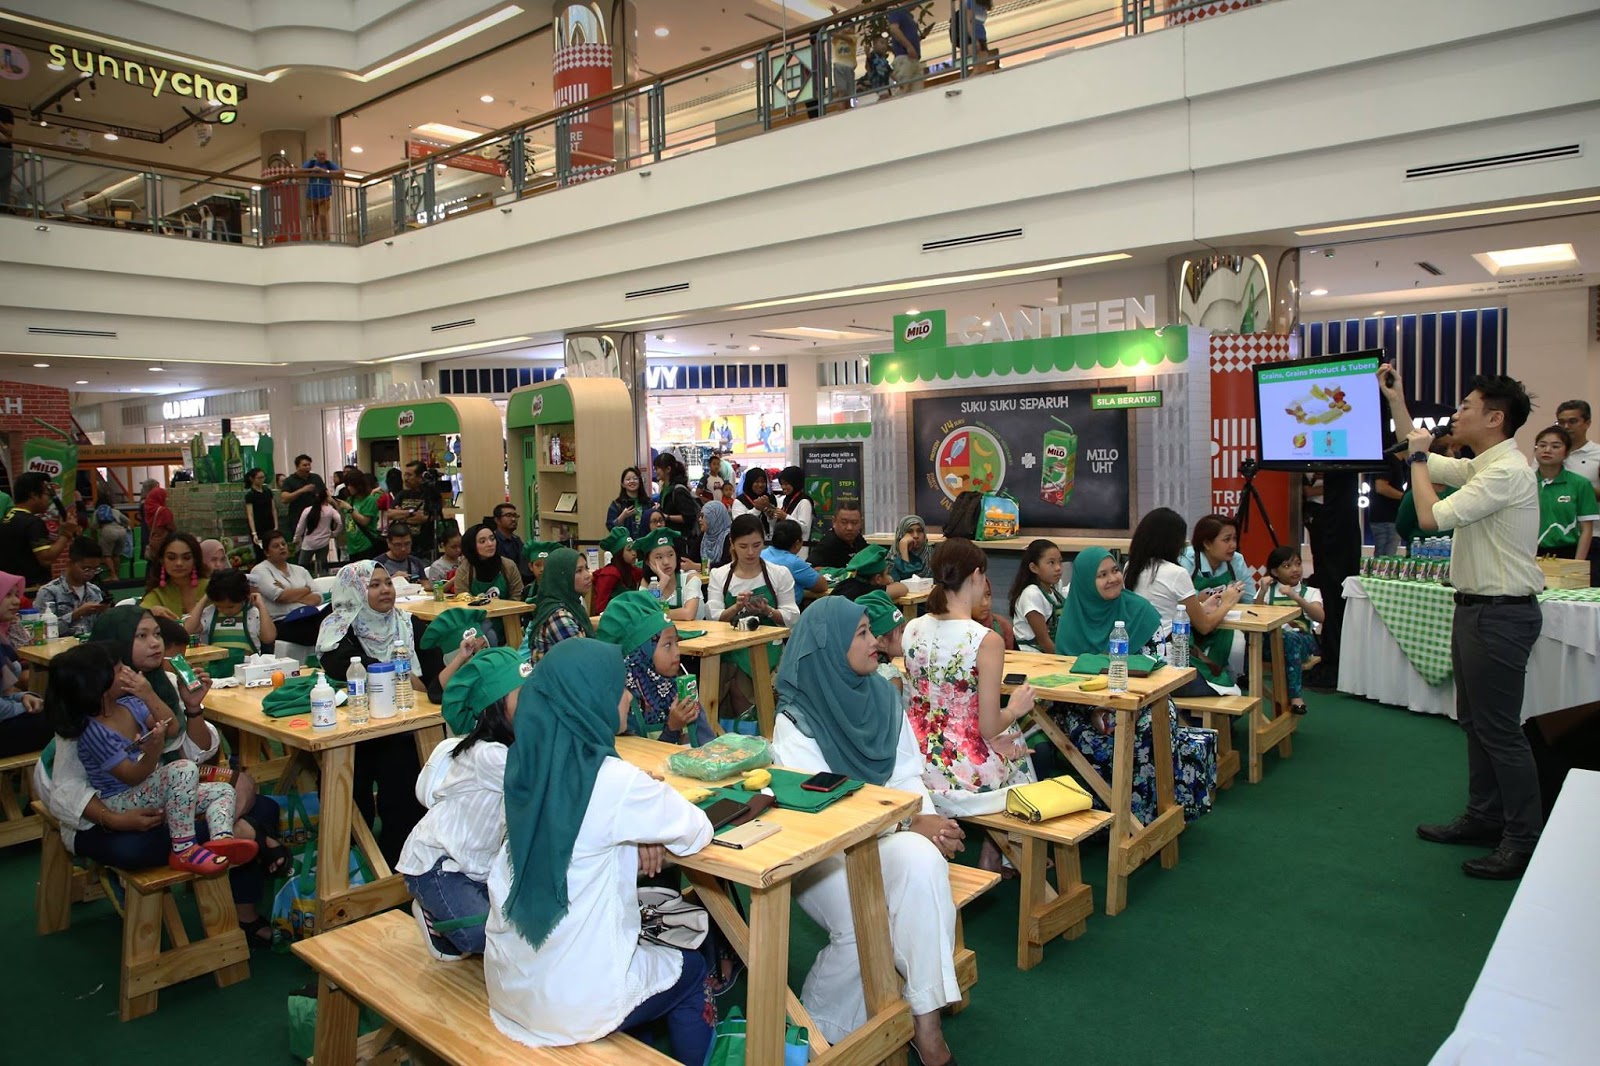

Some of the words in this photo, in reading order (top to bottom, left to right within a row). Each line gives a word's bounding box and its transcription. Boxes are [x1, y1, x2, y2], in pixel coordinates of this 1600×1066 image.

[49, 43, 238, 107] sunnycha
[956, 295, 1156, 345] CANTEEN
[906, 322, 930, 338] MILO
[1285, 370, 1308, 378] Grains
[1309, 366, 1339, 375] Product
[1348, 362, 1376, 371] Tubers
[961, 401, 987, 413] SUKU
[990, 399, 1017, 412] SUKU
[1019, 396, 1069, 410] SEPARUH
[1096, 398, 1115, 406] SILA
[1117, 395, 1157, 405] BERATUR
[399, 415, 413, 426] MILO
[1047, 447, 1065, 457] MILO
[1086, 449, 1119, 461] MILO
[29, 461, 59, 475] MILO
[1092, 461, 1113, 473] UHT
